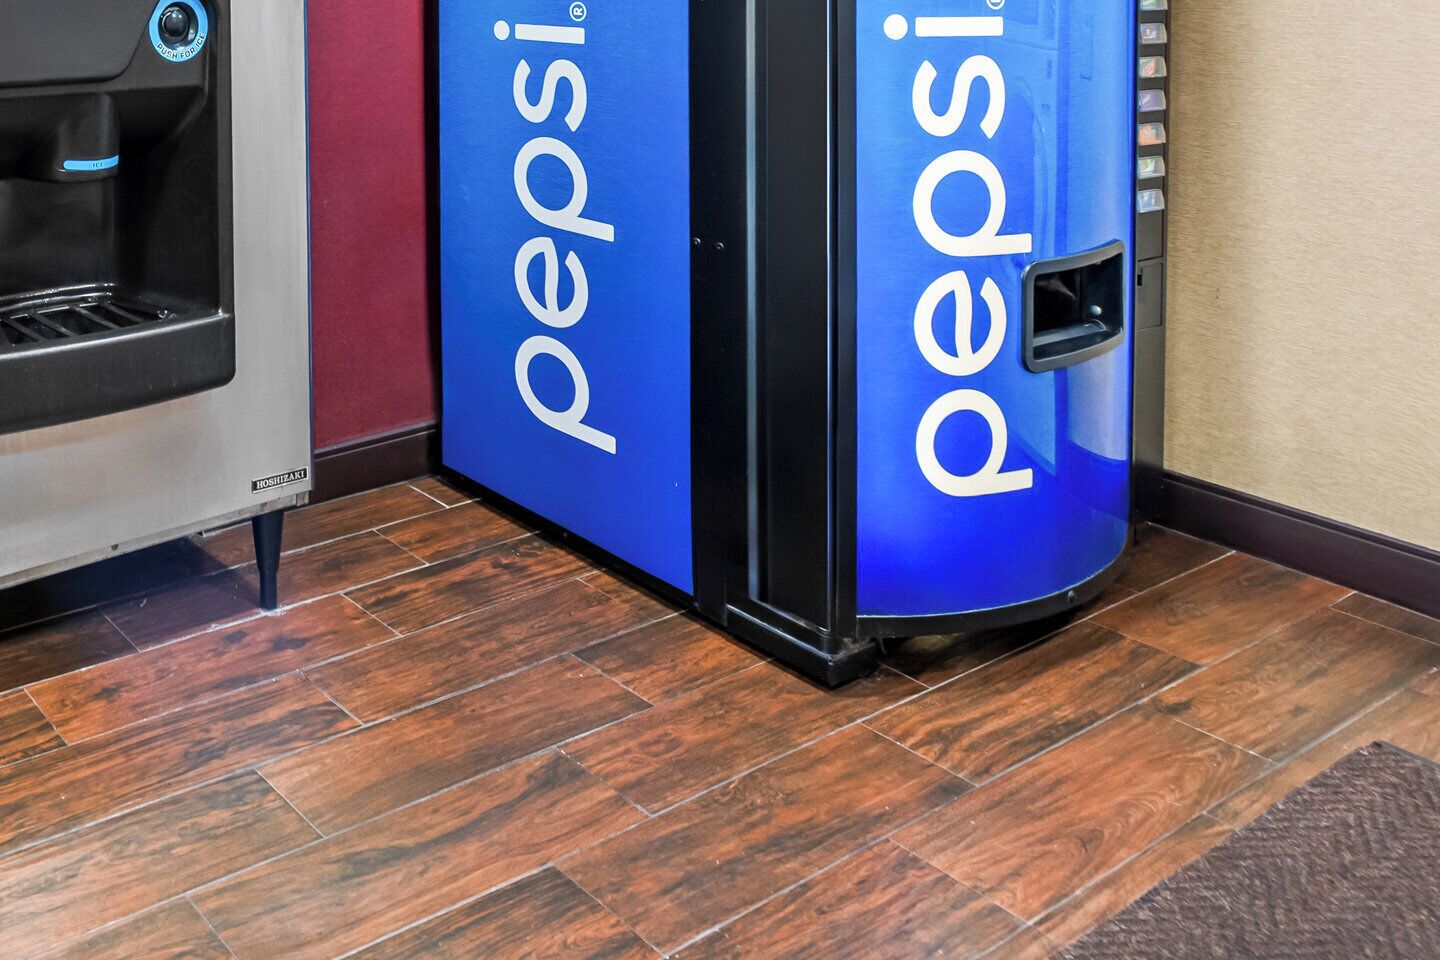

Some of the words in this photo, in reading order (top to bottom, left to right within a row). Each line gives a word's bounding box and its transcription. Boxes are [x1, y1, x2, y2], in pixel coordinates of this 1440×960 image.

[157, 43, 178, 59] PUSH
[181, 47, 197, 59] FOR
[196, 32, 206, 48] ICE
[493, 20, 617, 455] pepsi
[883, 13, 1033, 498] pepsi
[256, 470, 305, 489] HOSHIZAKI
